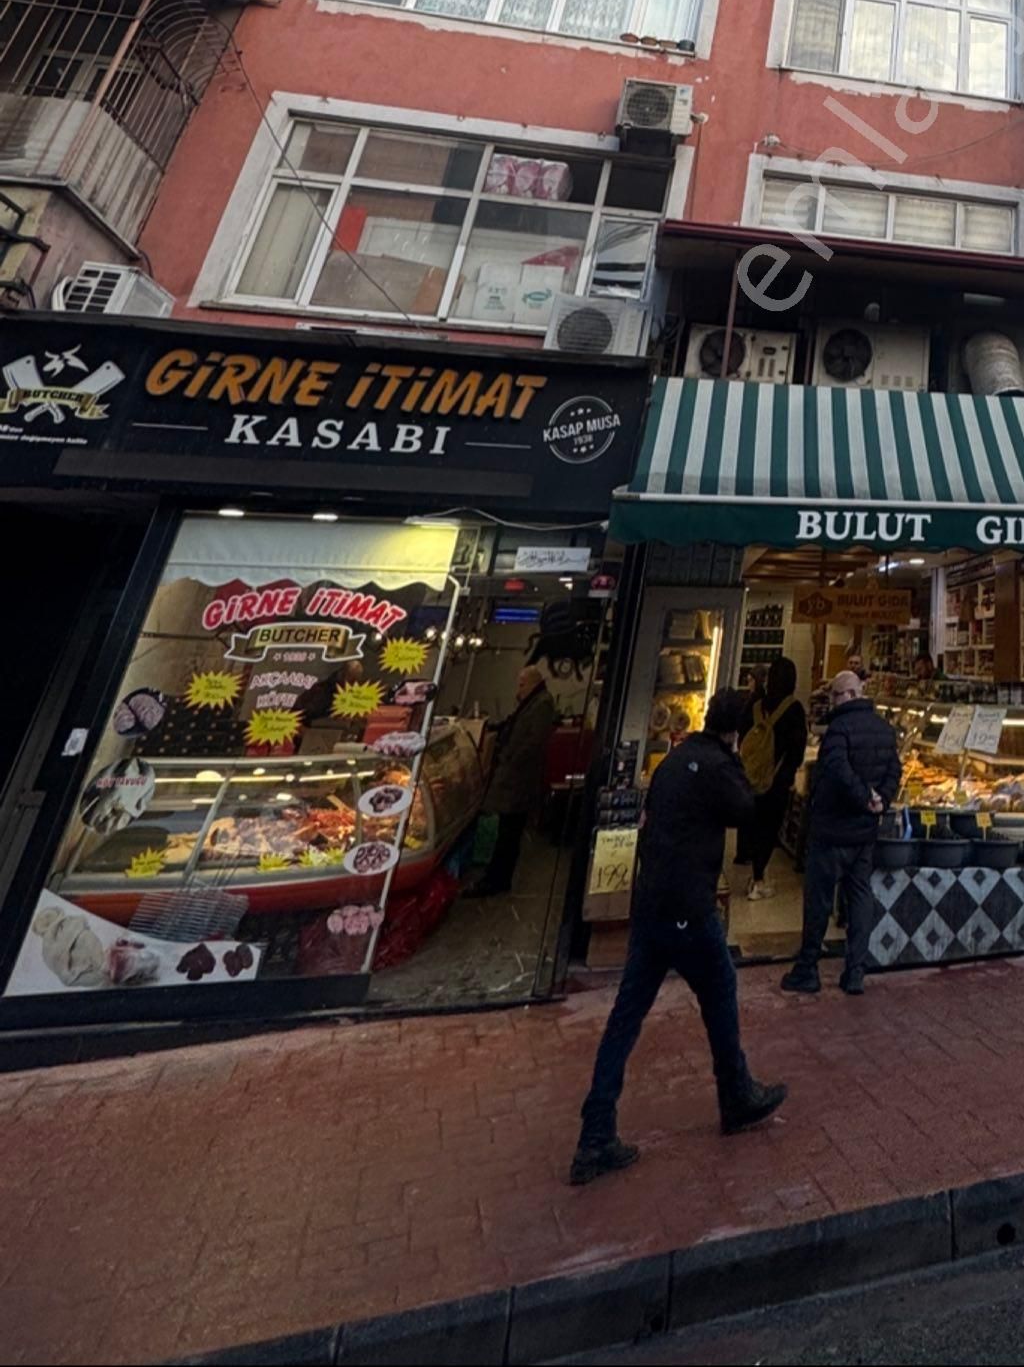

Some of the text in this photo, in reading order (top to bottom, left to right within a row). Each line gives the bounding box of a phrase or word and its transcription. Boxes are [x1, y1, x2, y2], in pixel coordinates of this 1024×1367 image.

[22, 389, 84, 403] BUTCHER
[224, 414, 452, 455] KASABI
[543, 413, 621, 443] KASAP MUSA
[796, 511, 932, 542] BULUT
[259, 628, 340, 643] BUTCHER
